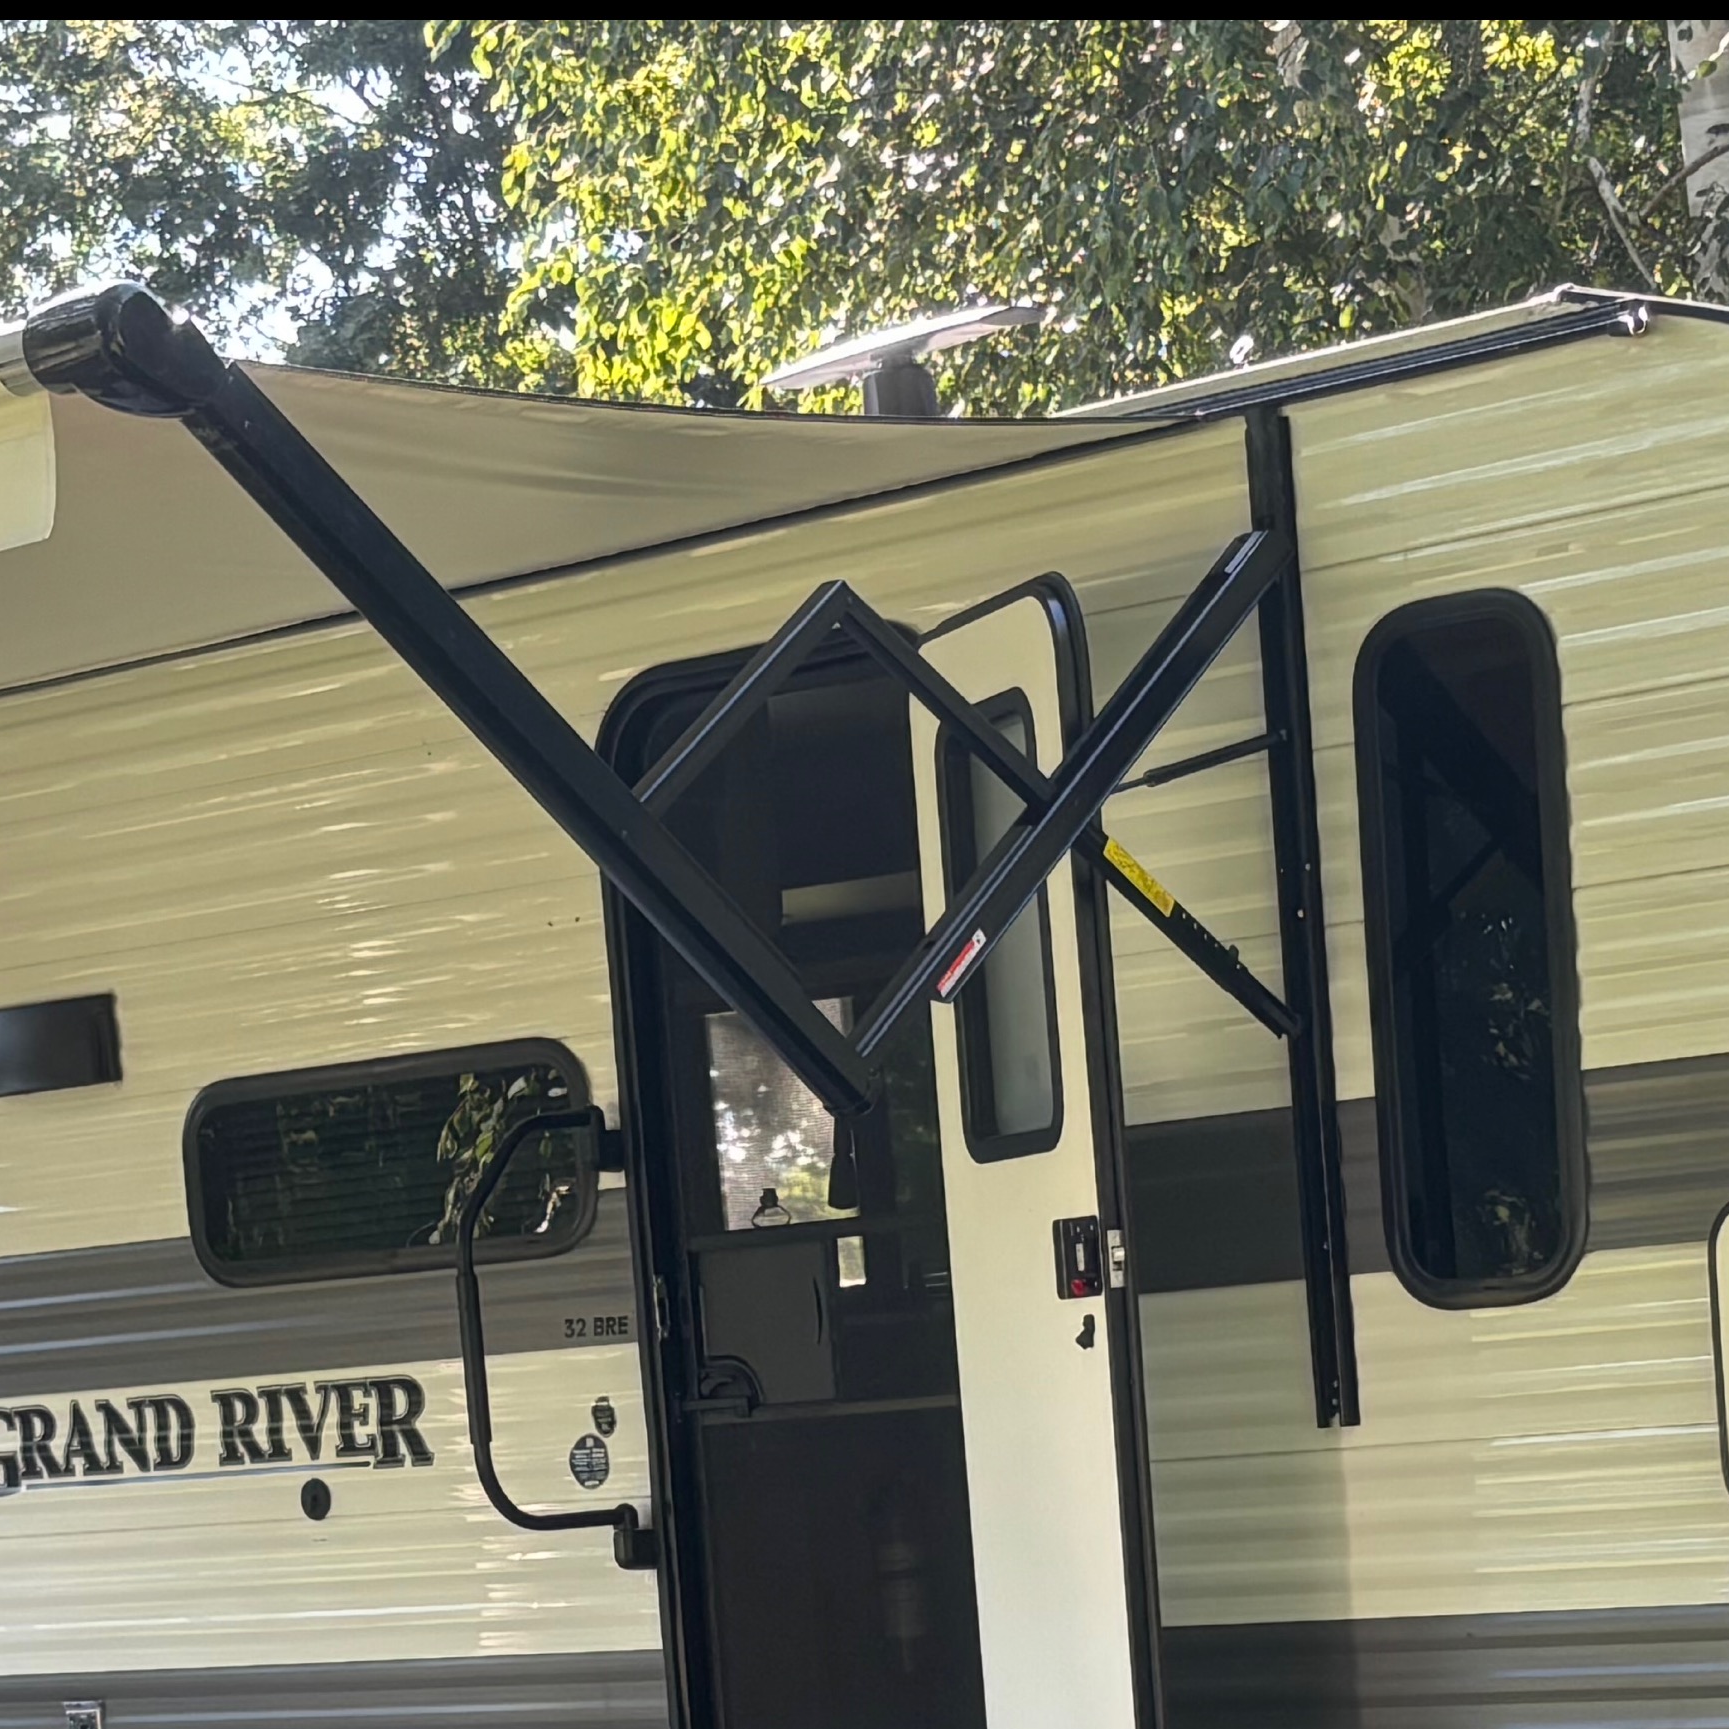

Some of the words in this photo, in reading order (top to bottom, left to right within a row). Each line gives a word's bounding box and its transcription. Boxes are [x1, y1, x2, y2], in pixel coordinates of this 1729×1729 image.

[564, 1318, 587, 1338] 32
[593, 1315, 629, 1336] BRE
[210, 1374, 435, 1469] RIVER
